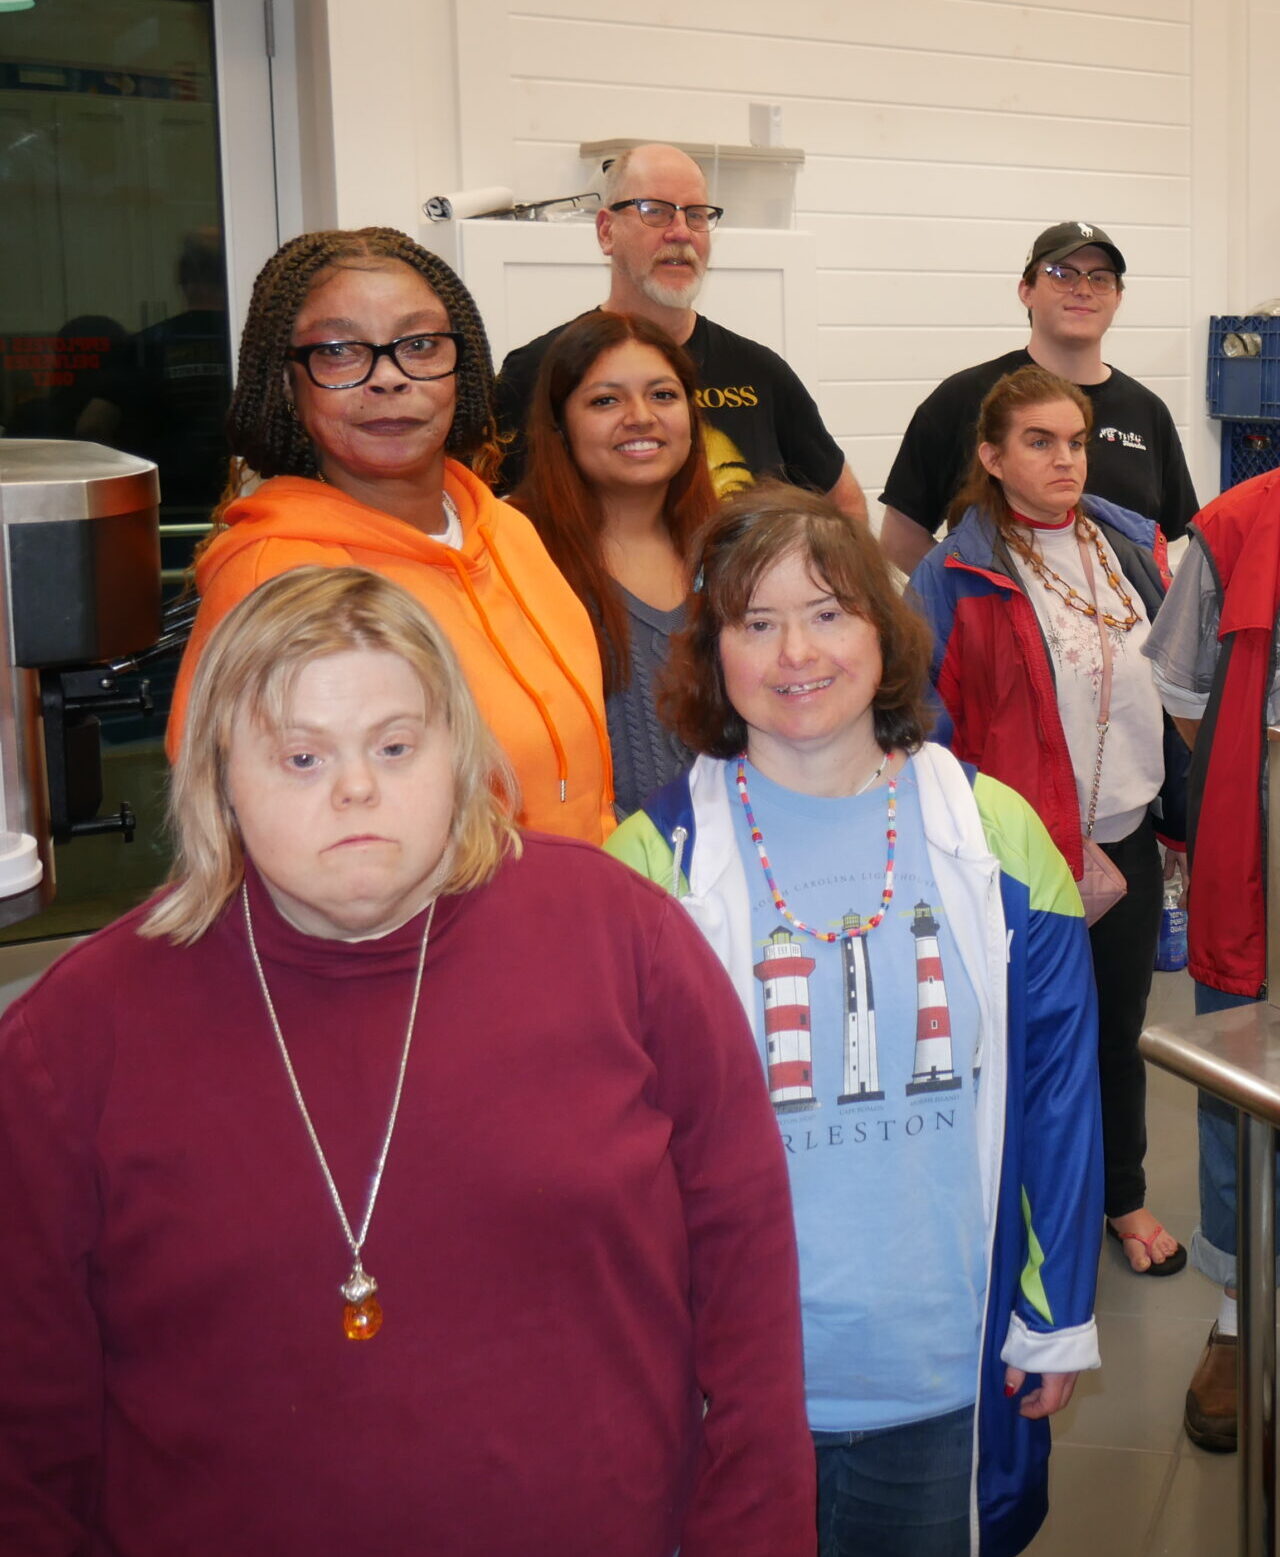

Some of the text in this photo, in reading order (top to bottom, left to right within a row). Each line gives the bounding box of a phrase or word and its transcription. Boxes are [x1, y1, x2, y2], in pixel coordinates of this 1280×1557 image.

[695, 386, 758, 408] ROSS
[794, 873, 856, 892] CAROLINA
[779, 1109, 957, 1154] RLESTON
